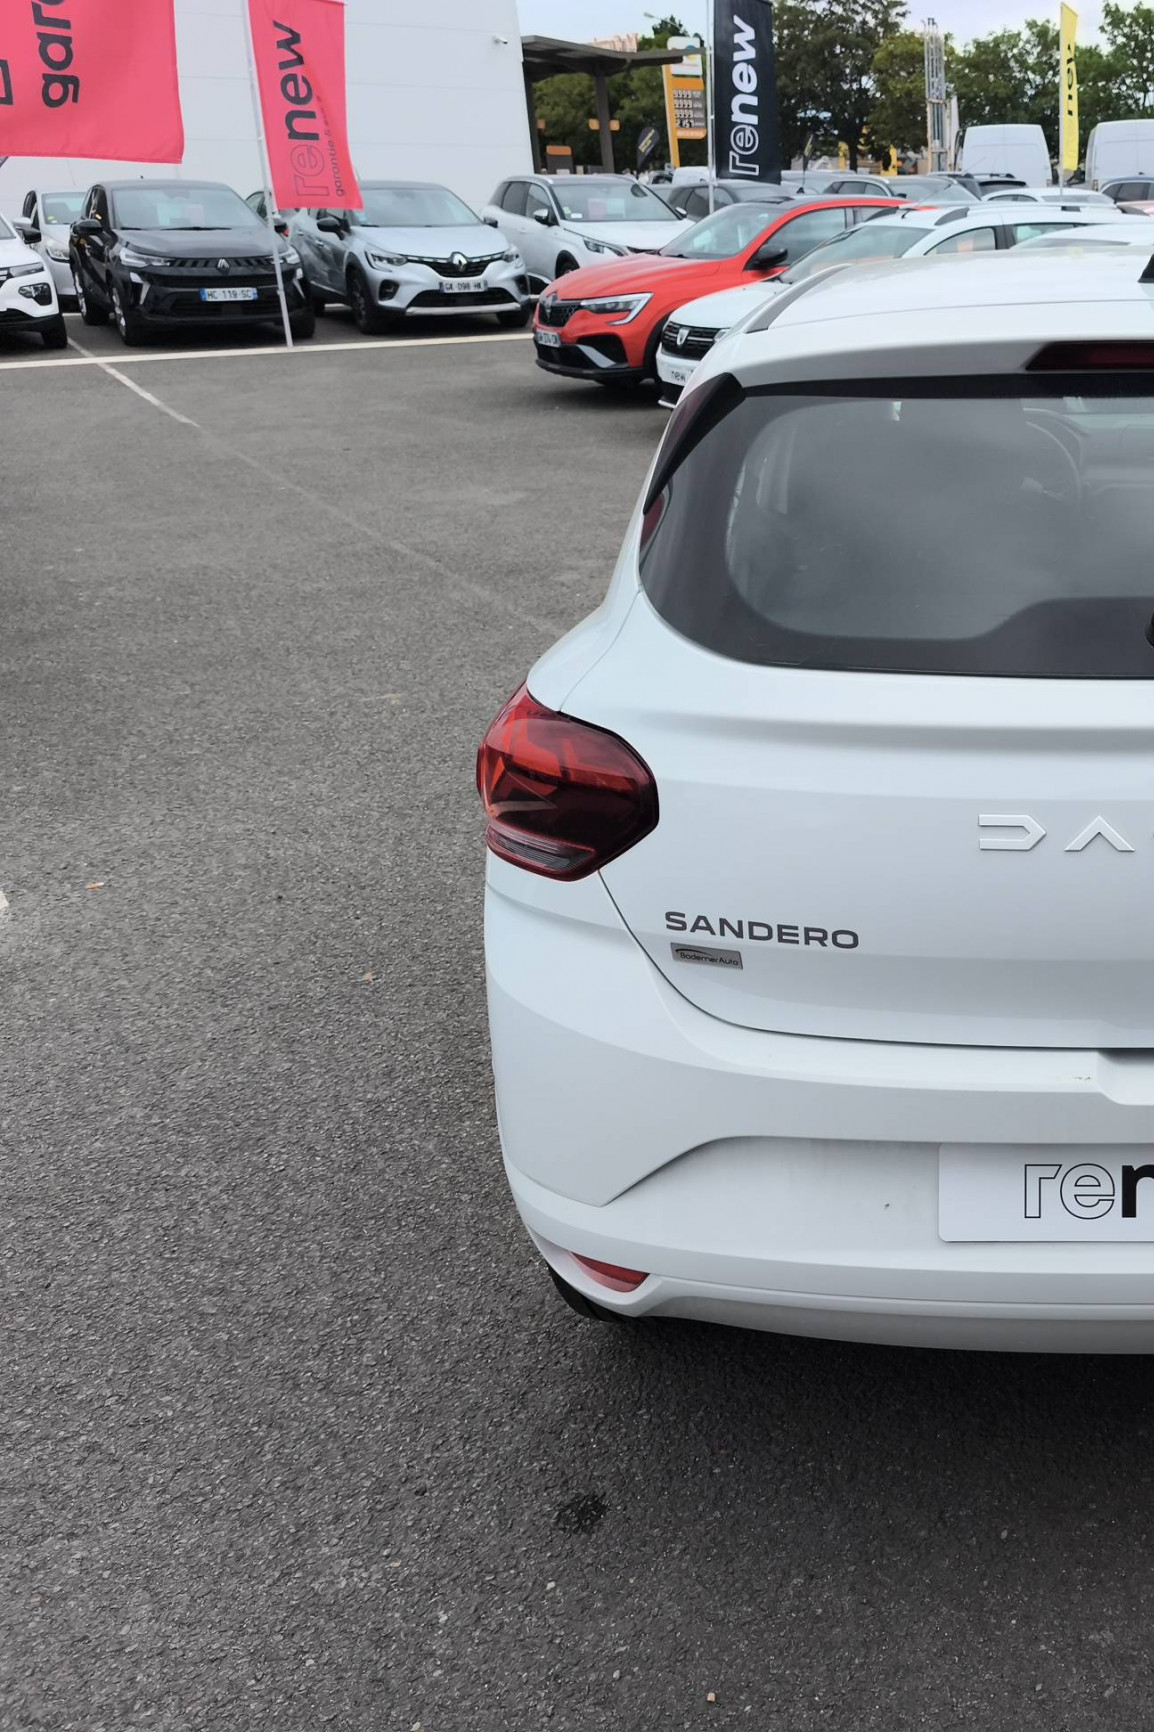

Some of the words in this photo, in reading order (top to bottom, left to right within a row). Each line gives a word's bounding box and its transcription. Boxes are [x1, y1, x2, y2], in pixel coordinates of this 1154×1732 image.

[32, 0, 79, 108] gar
[273, 20, 330, 197] renew
[729, 15, 760, 176] renew
[665, 911, 859, 949] SANDERO
